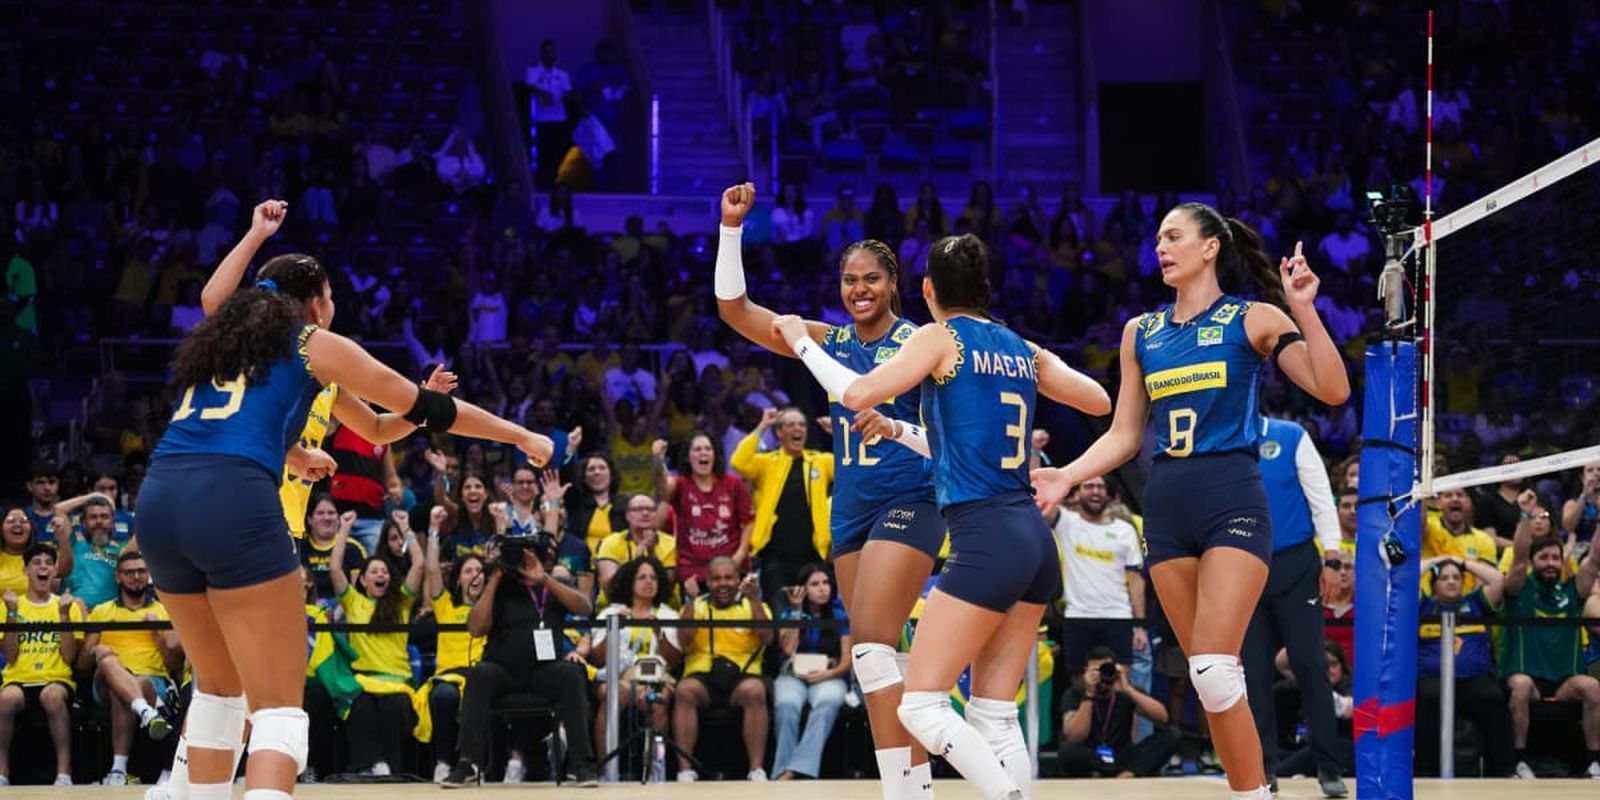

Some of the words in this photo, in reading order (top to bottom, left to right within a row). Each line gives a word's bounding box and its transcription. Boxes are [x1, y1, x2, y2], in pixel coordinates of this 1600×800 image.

[1153, 377, 1181, 390] BANCO
[1181, 375, 1192, 384] DO
[839, 416, 881, 466] 12
[1000, 391, 1027, 469] 3
[1165, 408, 1197, 457] 8
